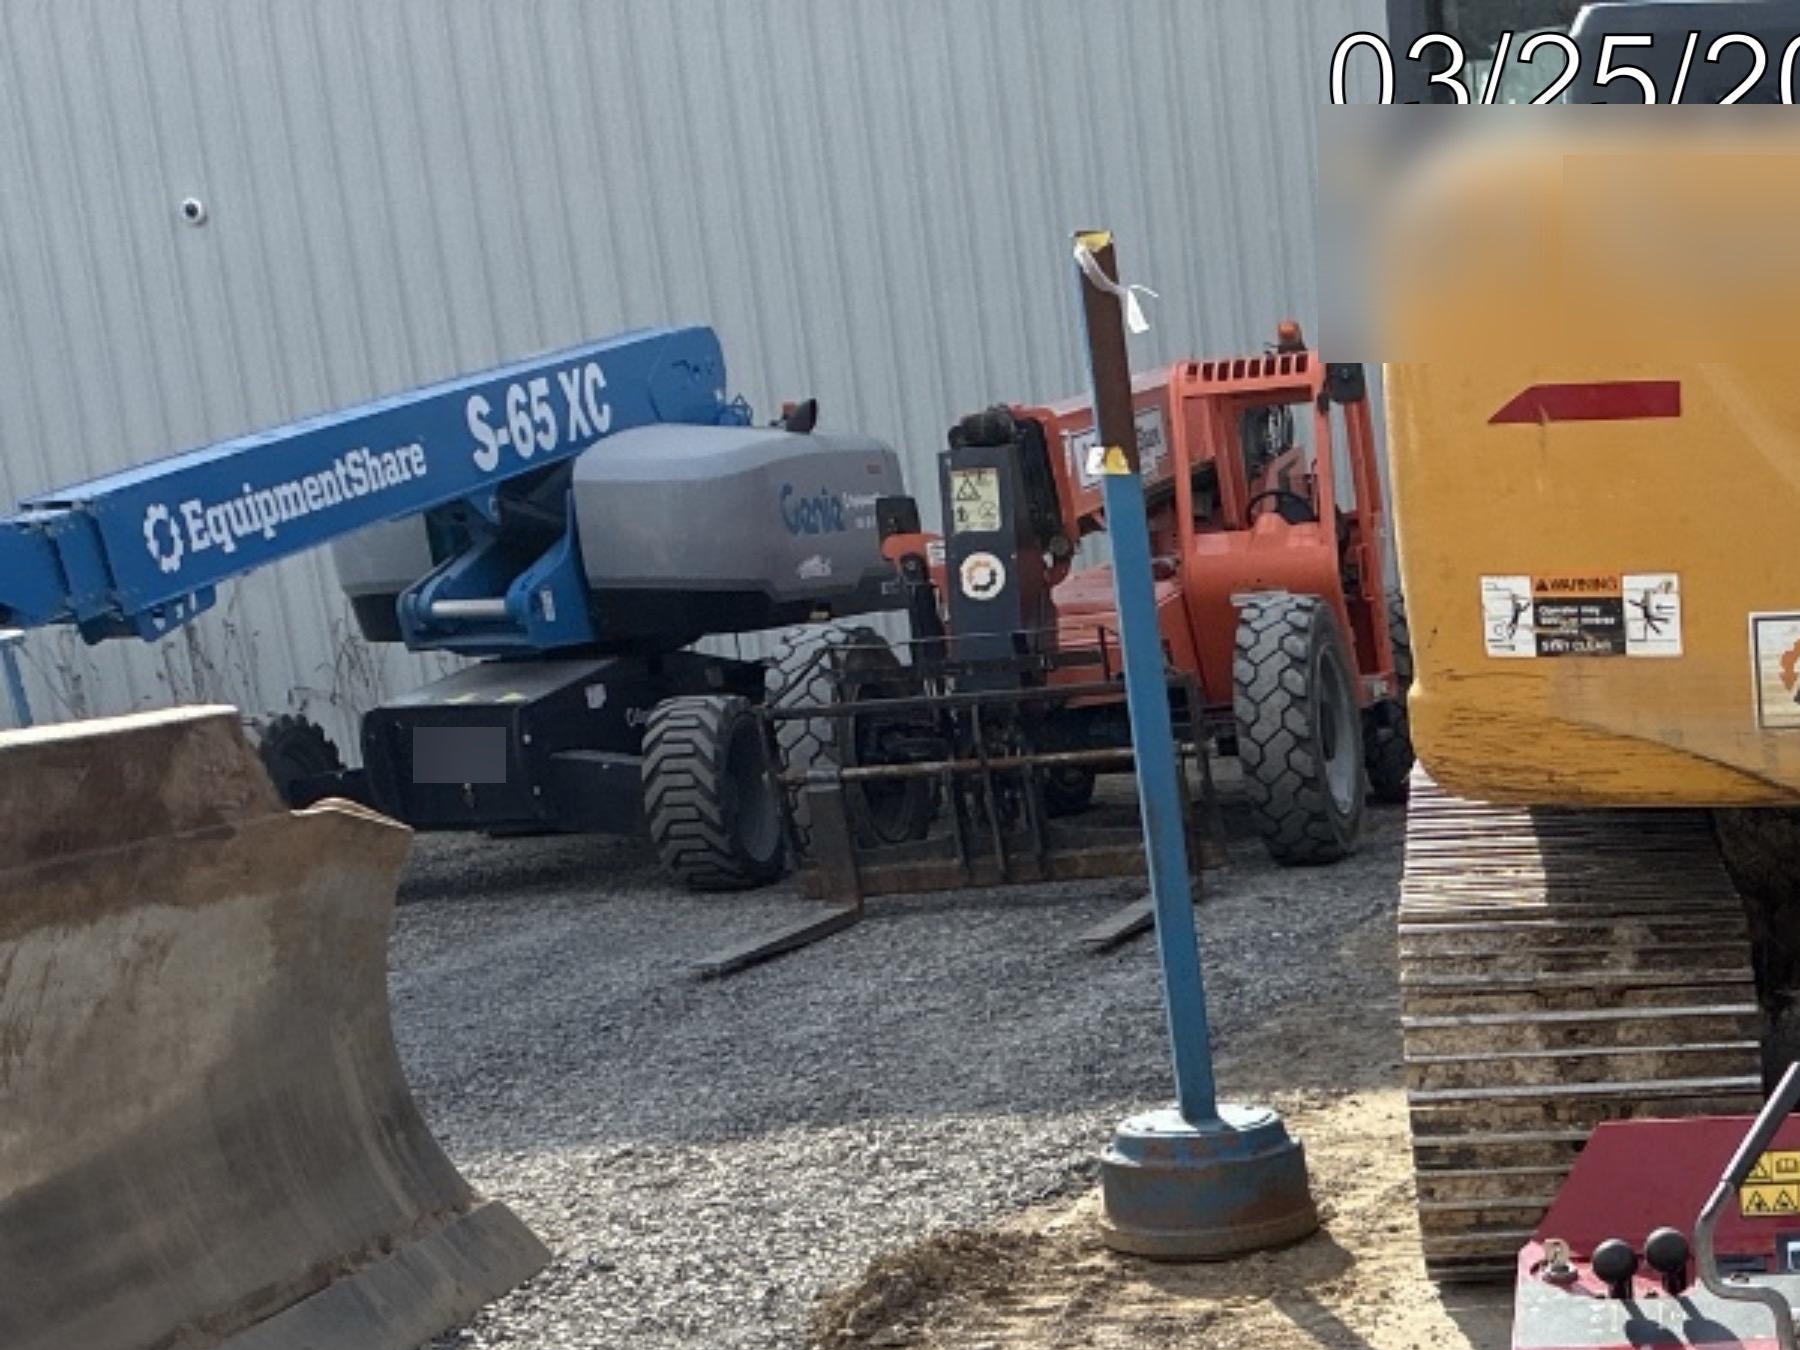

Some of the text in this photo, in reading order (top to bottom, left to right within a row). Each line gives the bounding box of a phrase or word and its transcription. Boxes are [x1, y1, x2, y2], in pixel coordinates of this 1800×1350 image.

[466, 361, 612, 473] S-65 XC
[180, 440, 427, 553] EquipmentShare
